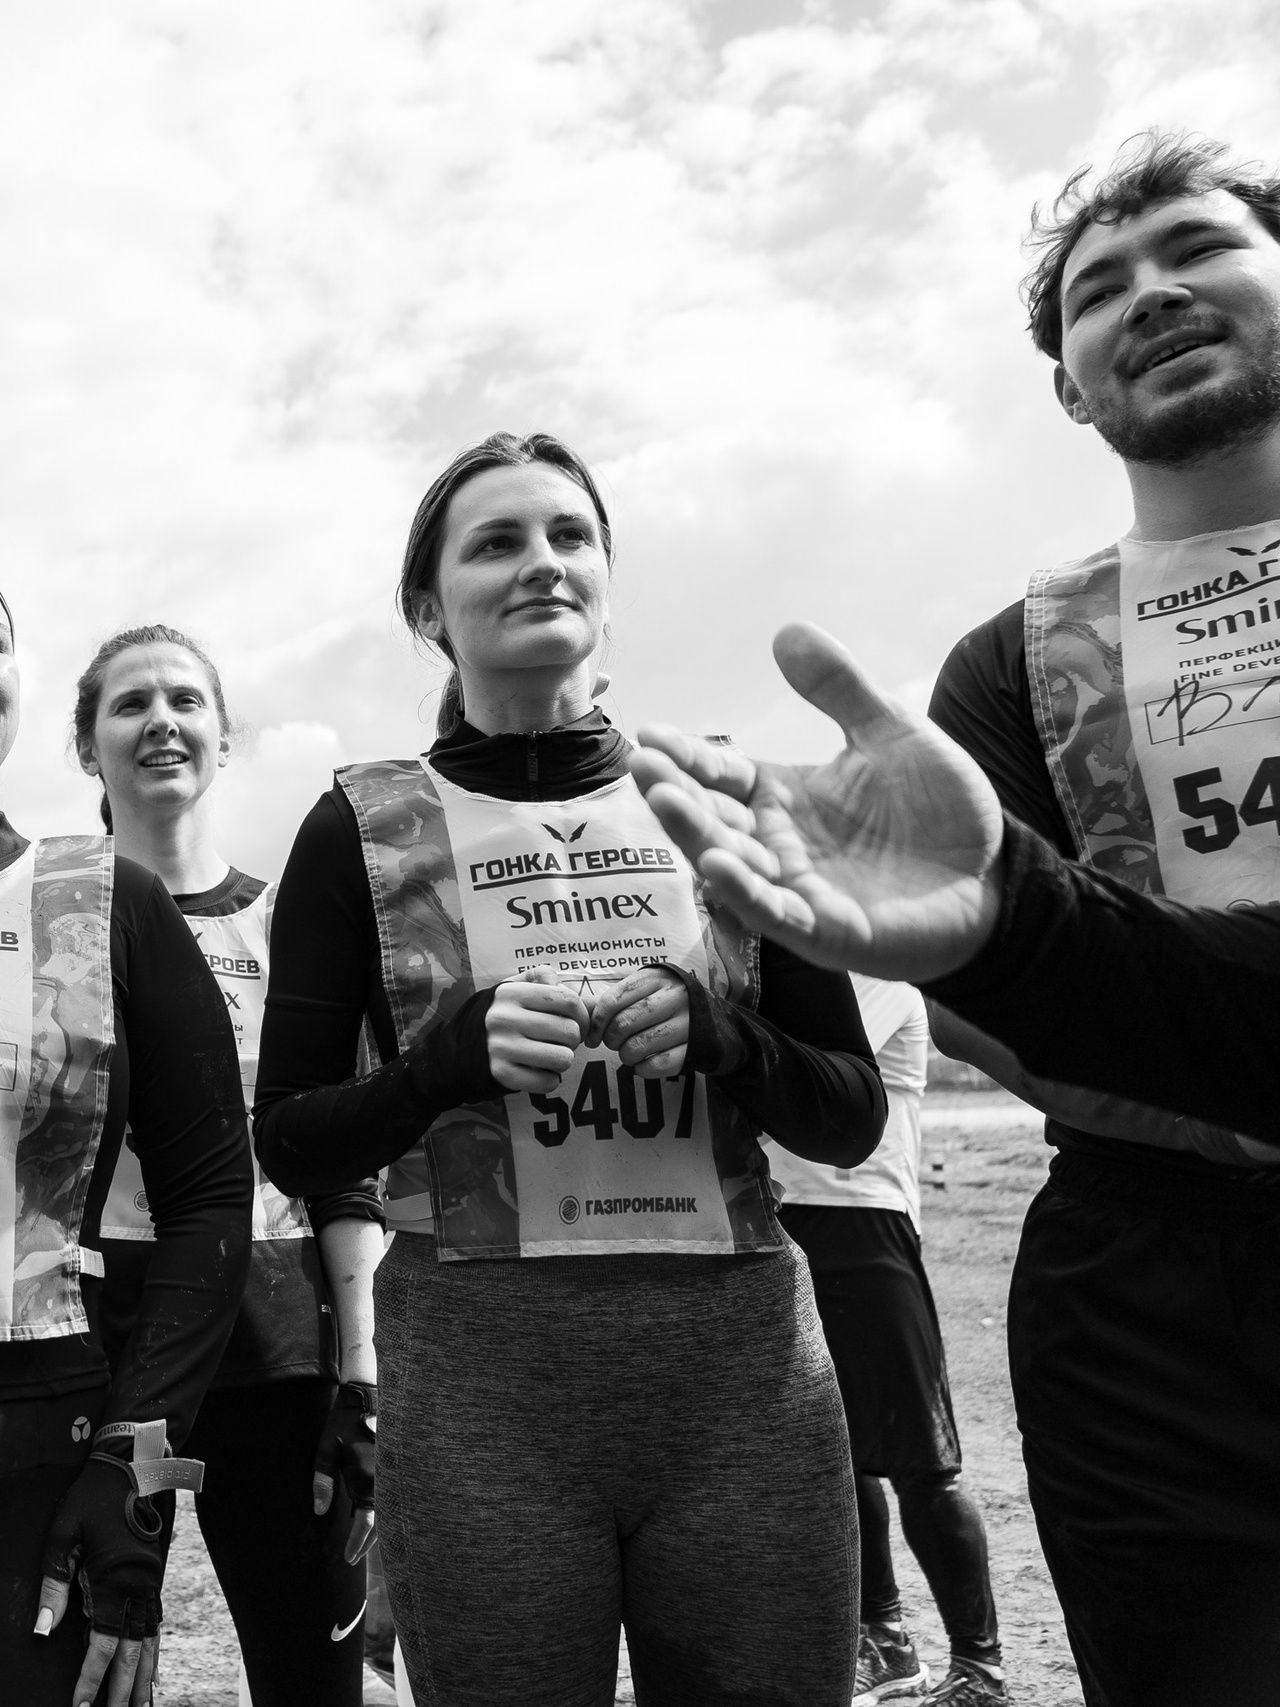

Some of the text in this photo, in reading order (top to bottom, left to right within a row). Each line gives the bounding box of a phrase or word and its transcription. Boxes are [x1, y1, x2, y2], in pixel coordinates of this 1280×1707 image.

[1136, 569, 1250, 616] ГОНКА
[1175, 597, 1280, 645] Smi
[1180, 667, 1223, 683] FINE
[469, 847, 675, 883] ГОНКА ГЕРОЕВ
[506, 891, 658, 929] Sminex
[514, 937, 666, 958] ПЕРФЕКЦИОНИСТЫ
[203, 953, 260, 974] РОЕВ
[585, 1197, 698, 1216] ГАЗПРОМБАНК
